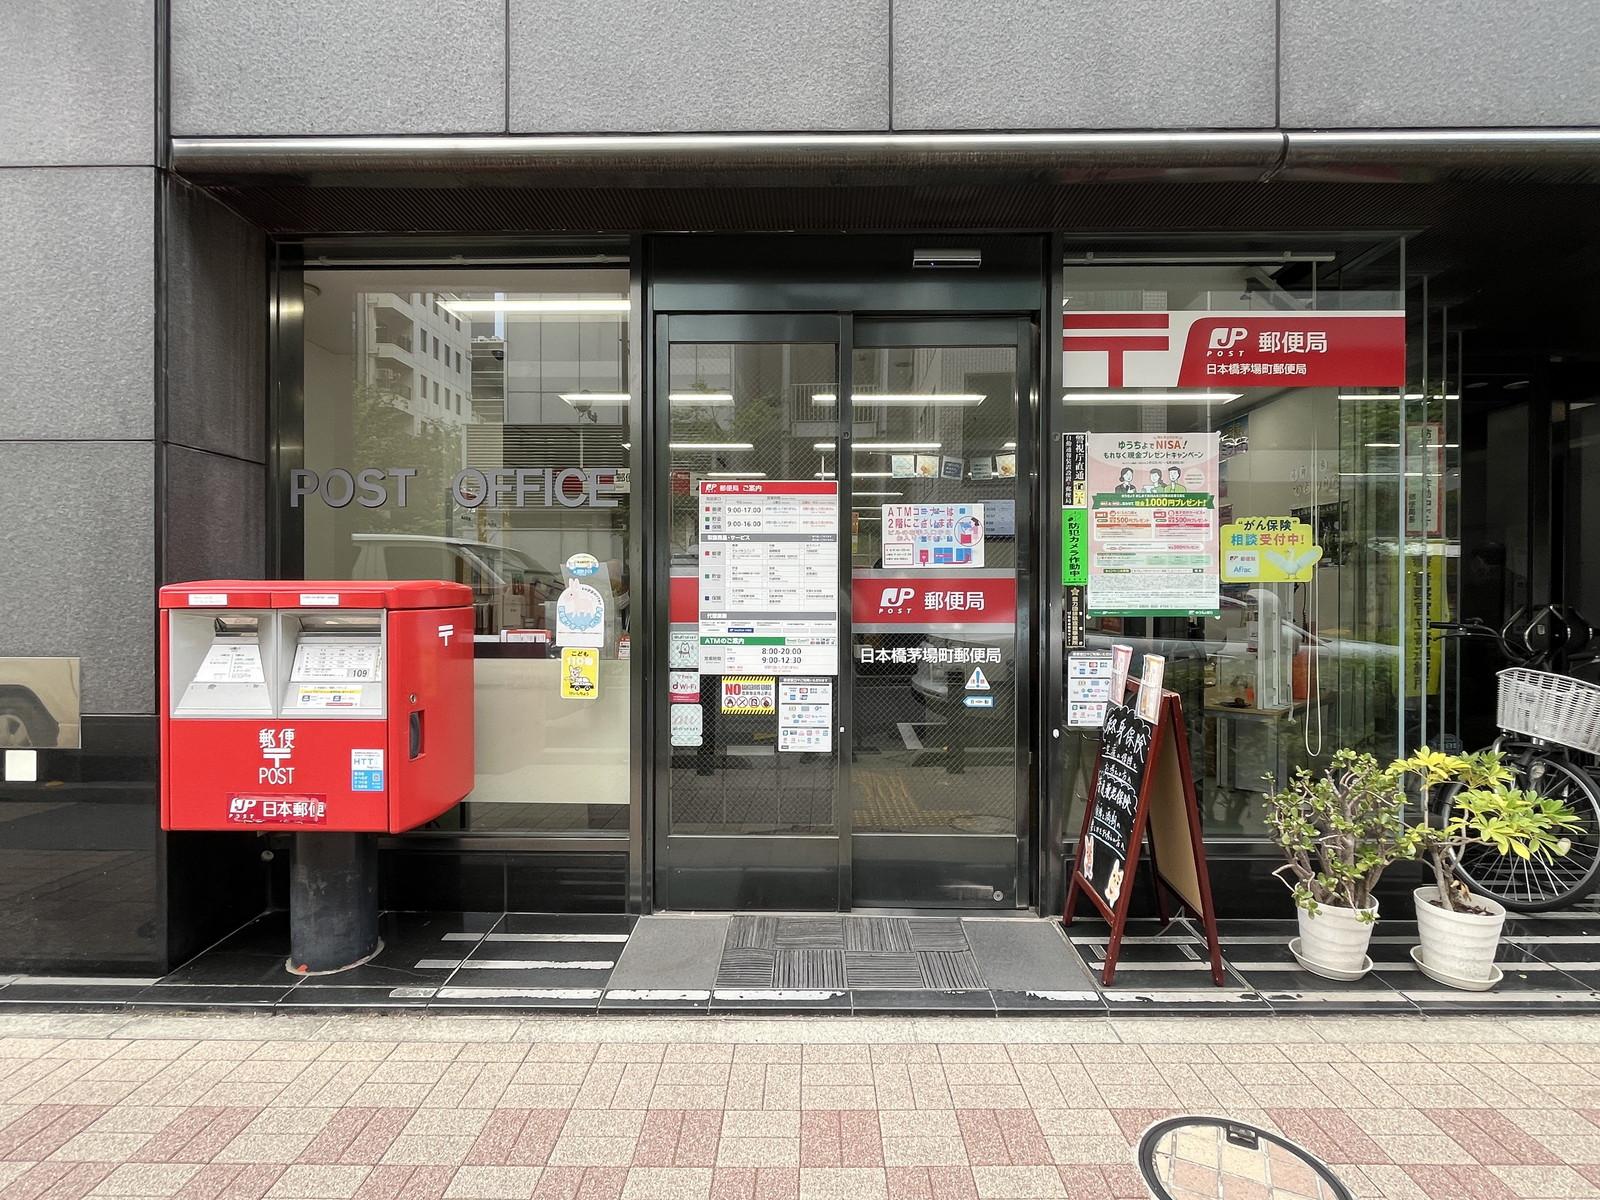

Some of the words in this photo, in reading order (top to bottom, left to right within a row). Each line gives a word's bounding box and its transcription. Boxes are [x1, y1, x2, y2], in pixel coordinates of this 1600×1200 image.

[1258, 331, 1328, 354] 郵便局
[1206, 350, 1245, 358] POST
[1206, 363, 1307, 376] 日本橋茅場町郵便局
[290, 467, 418, 508] POST
[451, 467, 620, 509] OFFICE
[888, 506, 954, 516] ATMコーナーは
[888, 518, 954, 529] 2階にございます
[1231, 534, 1304, 546] 相談受付中!
[1068, 523, 1080, 577] 防犯カメラ作動中
[924, 591, 985, 611] 郵便局
[860, 648, 1001, 664] 日本橋茅場町郵便局
[352, 669, 368, 678] 109
[725, 683, 741, 696] NO
[258, 728, 296, 749] 郵便
[259, 767, 295, 785] POST
[263, 801, 325, 817] 日本郵便
